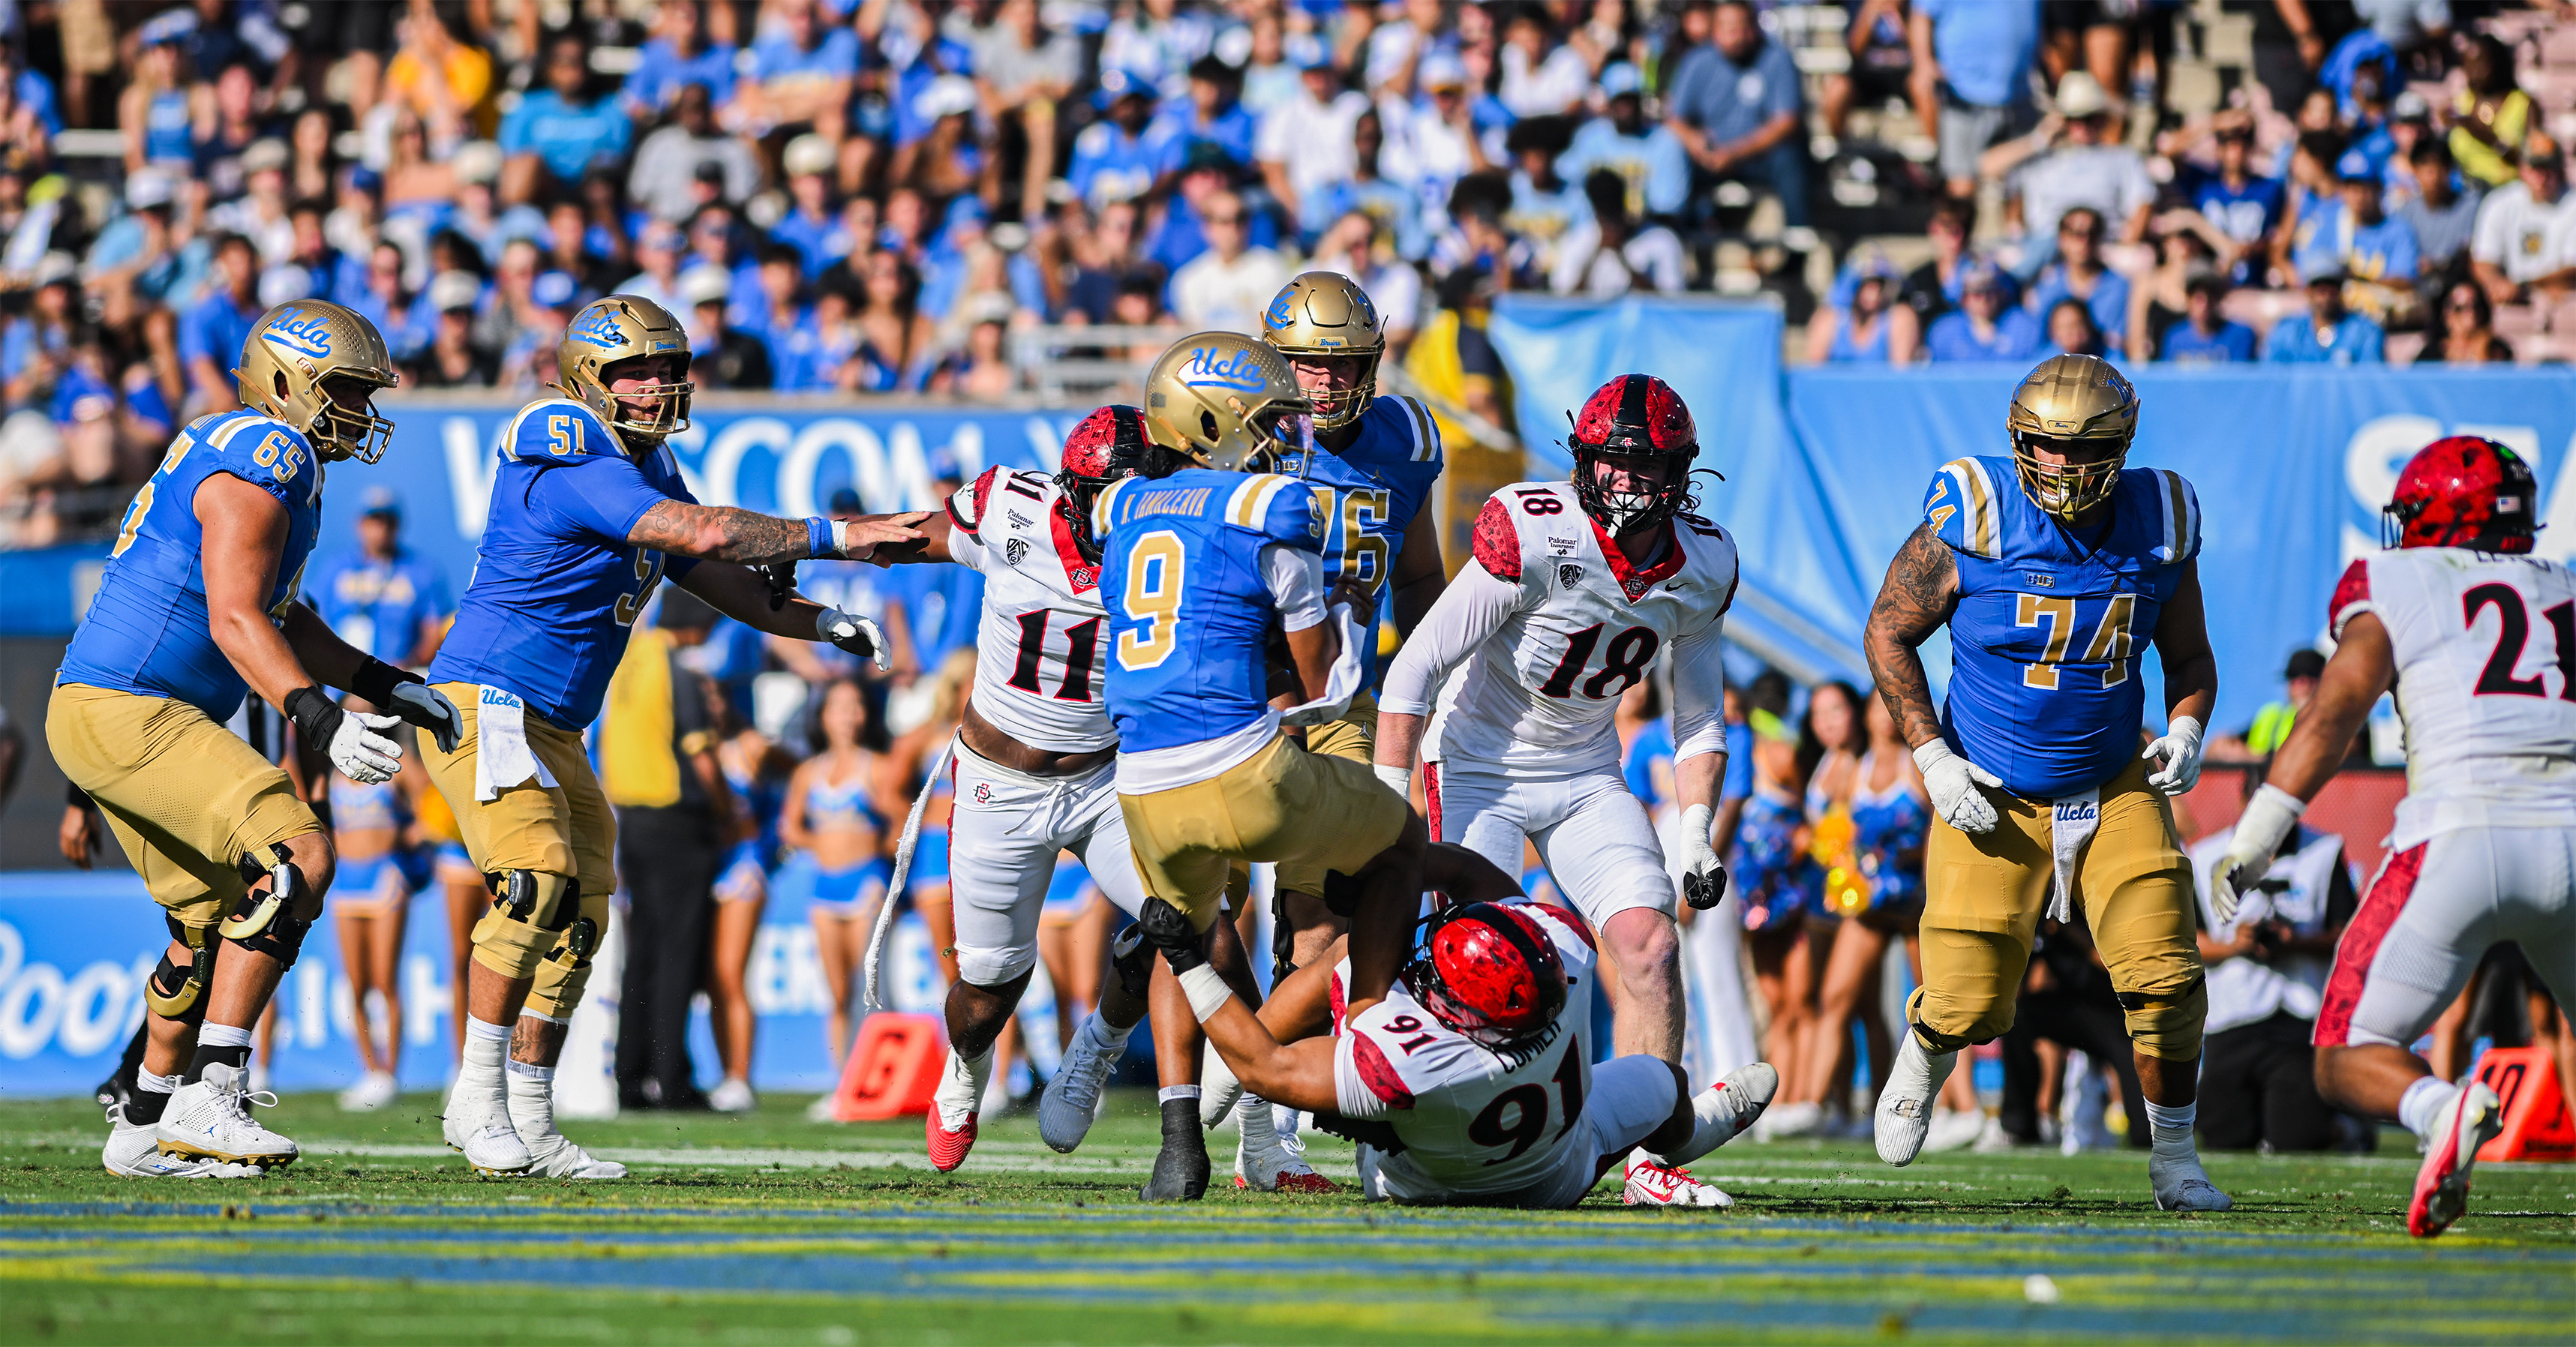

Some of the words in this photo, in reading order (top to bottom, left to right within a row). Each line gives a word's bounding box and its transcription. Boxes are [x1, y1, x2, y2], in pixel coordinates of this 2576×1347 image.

[263, 307, 331, 358] Ucla
[655, 342, 677, 350] Bruins
[1187, 347, 1266, 394] Ucla
[549, 415, 587, 455] 51
[253, 430, 306, 483] 65
[1004, 471, 1049, 503] 11
[1514, 488, 1563, 516] 18
[1925, 478, 1957, 536] 74
[1007, 508, 1035, 526] Palomar
[1007, 515, 1031, 528] Insurance
[1306, 496, 1326, 538] 9
[1548, 536, 1577, 545] Palomar
[1115, 530, 1185, 672] 9
[1005, 608, 1092, 703] 11
[1536, 622, 1659, 700] 18
[2015, 592, 2136, 691] 74
[482, 689, 521, 708] Ucla
[2057, 801, 2097, 821] Ucla
[1381, 1015, 1439, 1058] 91
[1468, 1033, 1584, 1167] 91
